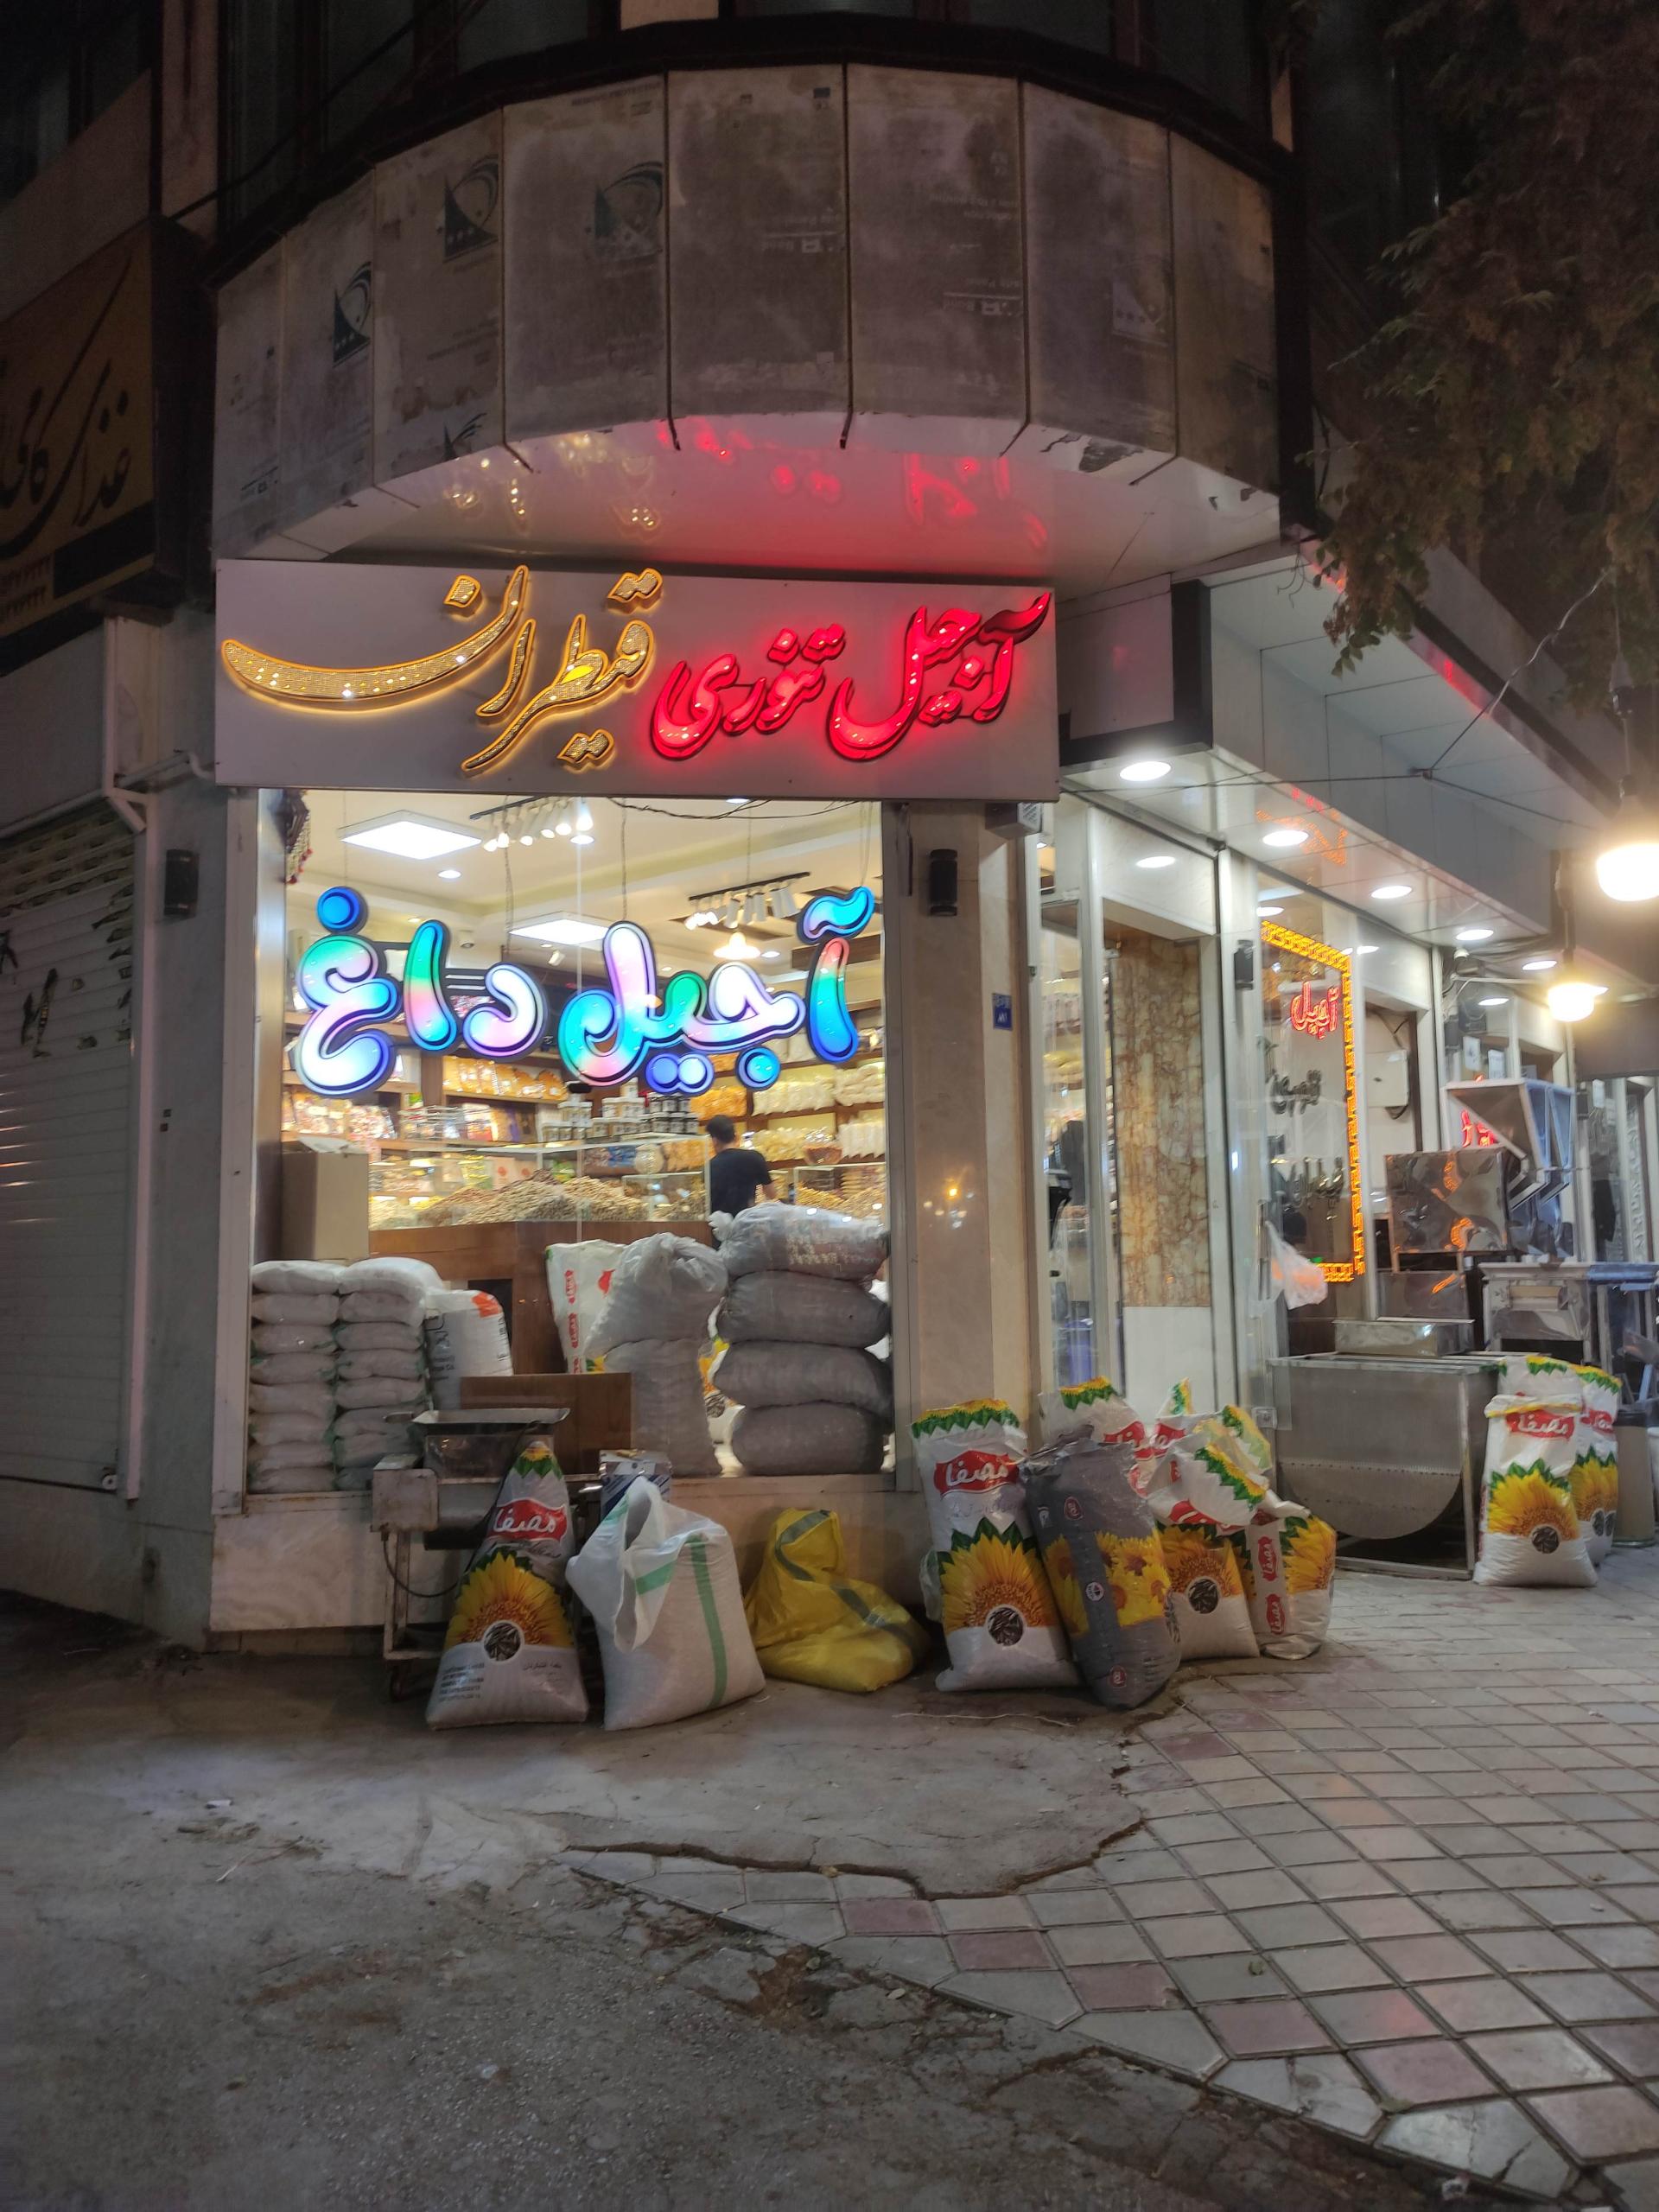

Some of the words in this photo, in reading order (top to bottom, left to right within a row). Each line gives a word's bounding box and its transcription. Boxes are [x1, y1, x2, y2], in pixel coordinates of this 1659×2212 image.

[650, 622, 847, 760] تنوری
[825, 591, 1052, 762] آجیل
[296, 886, 550, 1096] داغ
[557, 886, 875, 1094] آجیل
[1291, 981, 1340, 1039] آجیل
[944, 1460, 1010, 1487] مصفا
